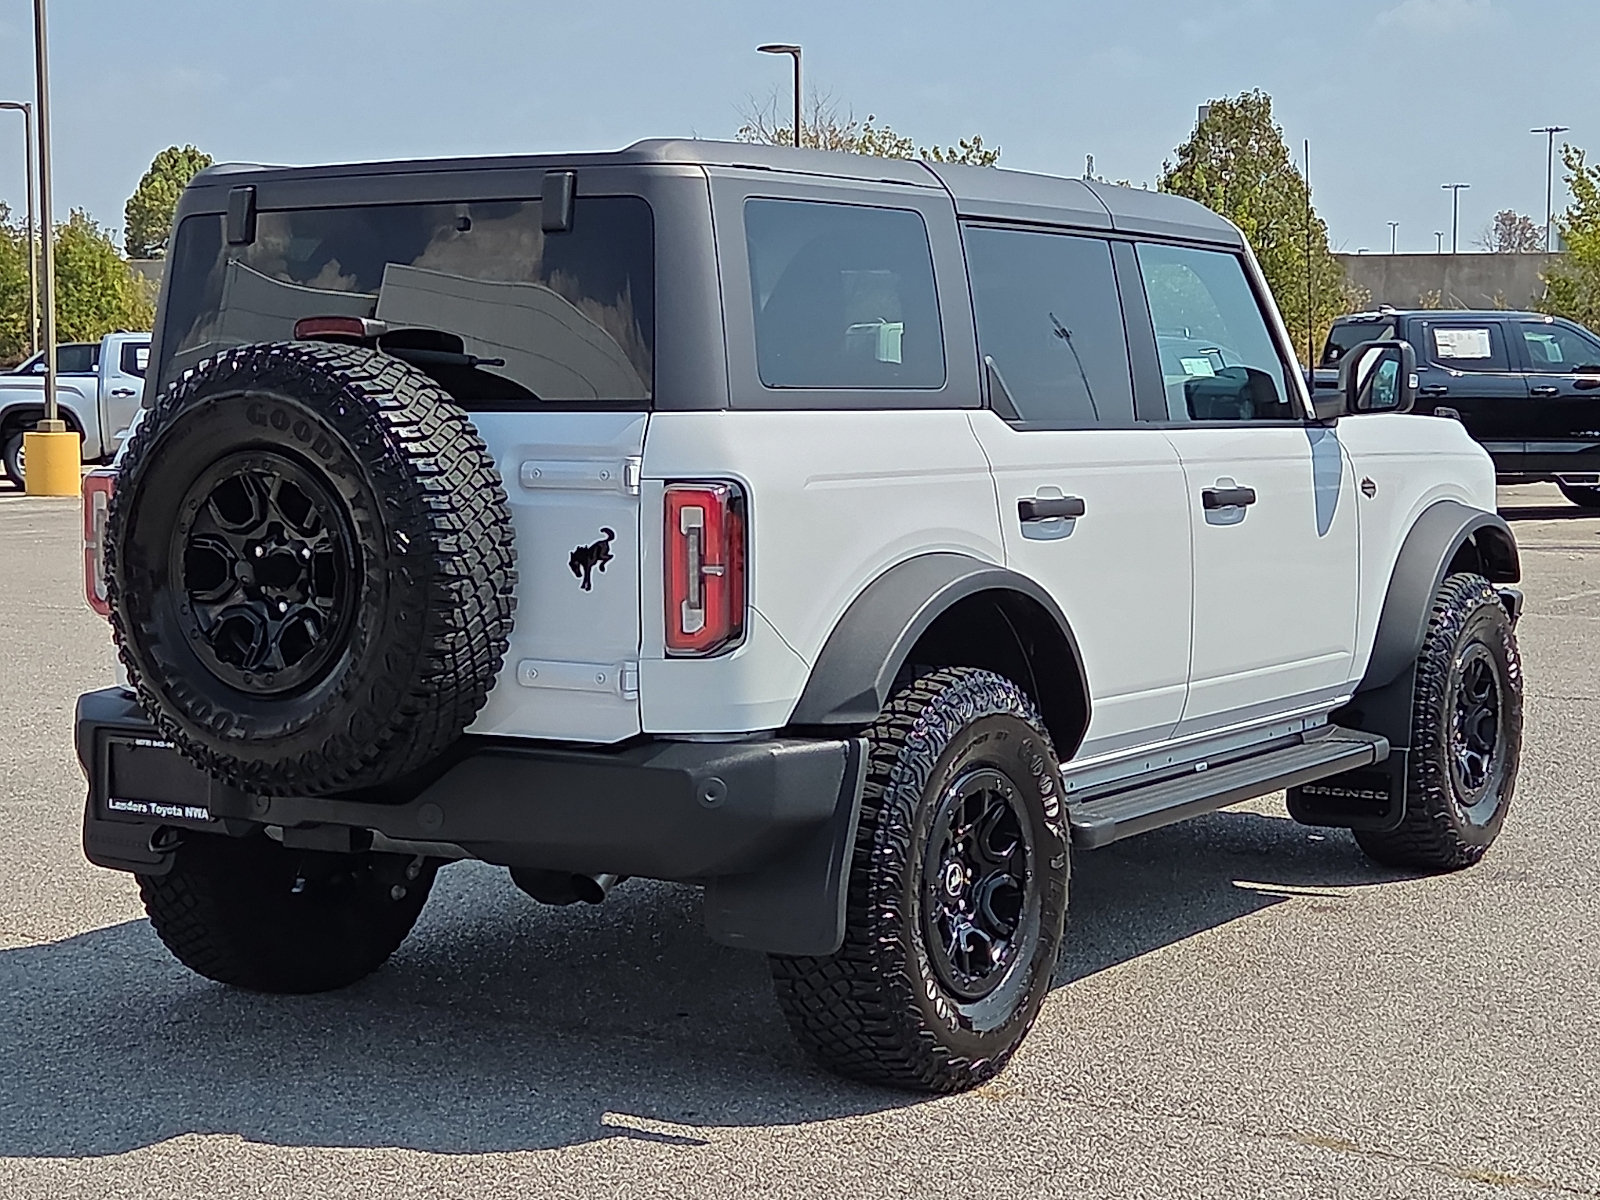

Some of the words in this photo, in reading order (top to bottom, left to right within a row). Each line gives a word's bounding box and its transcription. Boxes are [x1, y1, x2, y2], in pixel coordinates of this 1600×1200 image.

[1302, 785, 1389, 800] BRONCO
[109, 798, 148, 813] Landers
[149, 803, 183, 817] Toyota
[184, 807, 209, 820] NWA
